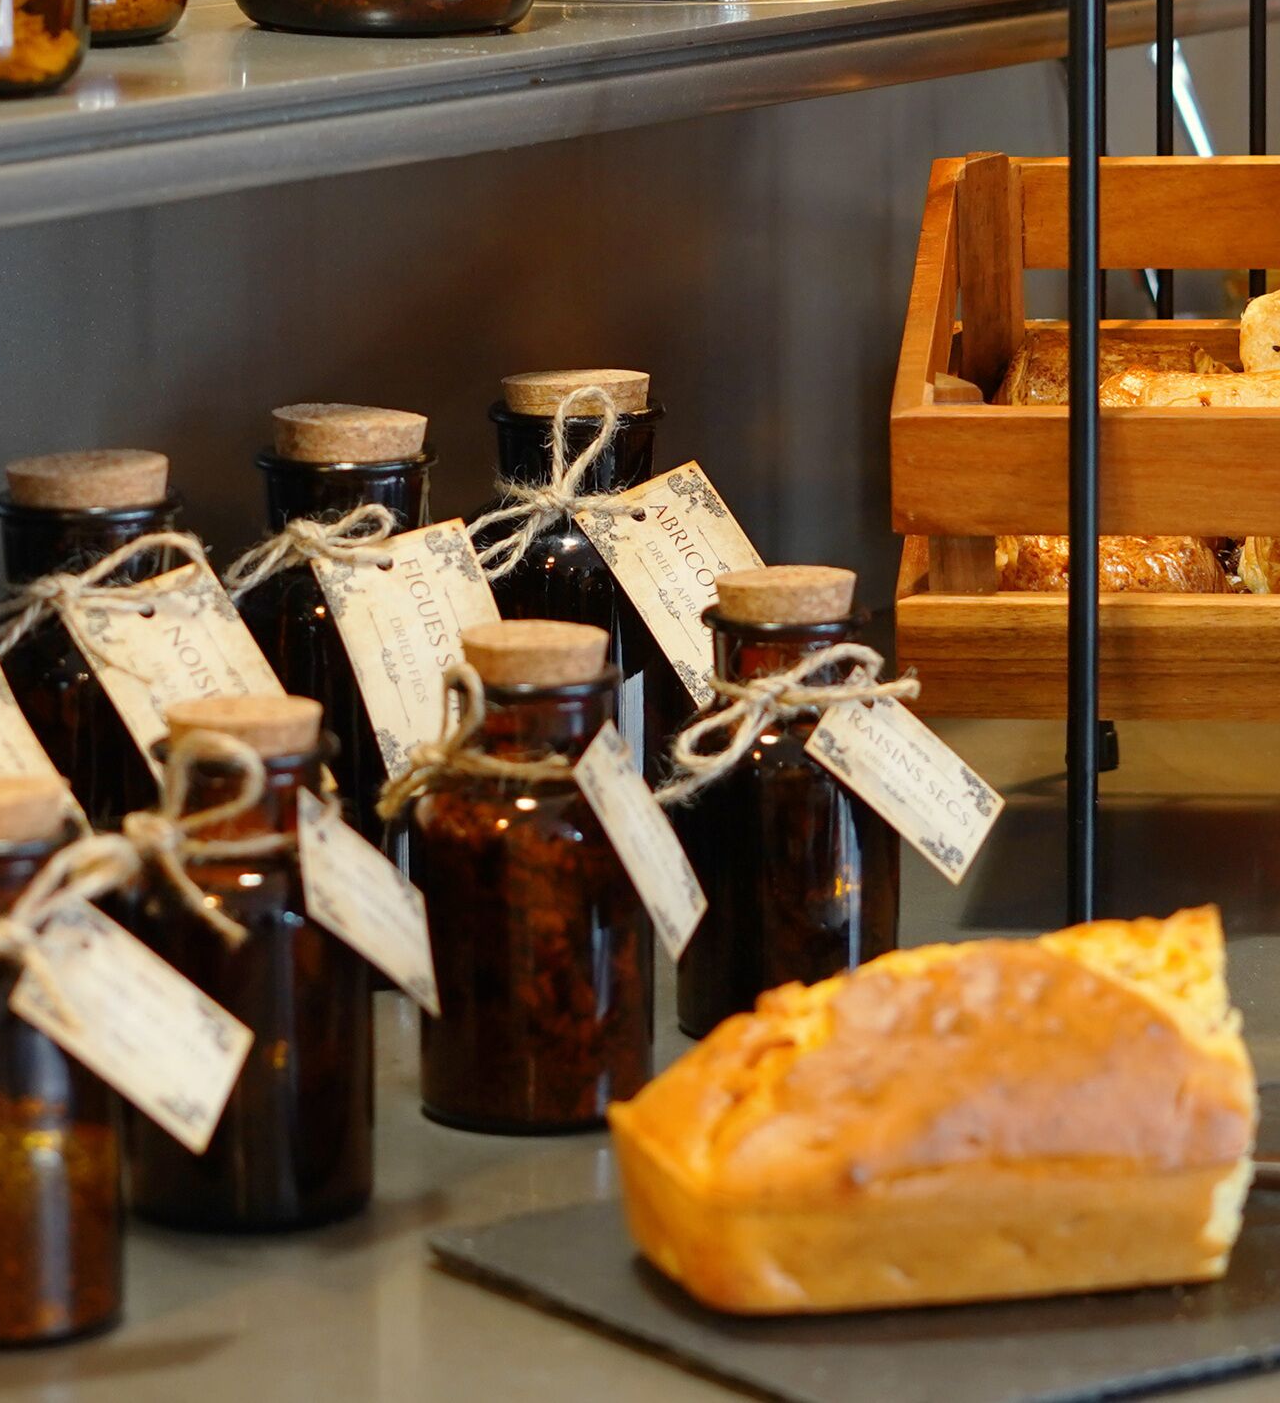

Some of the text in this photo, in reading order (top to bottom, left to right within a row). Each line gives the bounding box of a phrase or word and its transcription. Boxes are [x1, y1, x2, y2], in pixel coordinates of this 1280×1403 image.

[399, 557, 450, 647] FIGUES
[645, 539, 713, 644] DRIED APRICO
[389, 615, 430, 704] DRIED FIGS
[847, 708, 972, 827] RAISINS SECS
